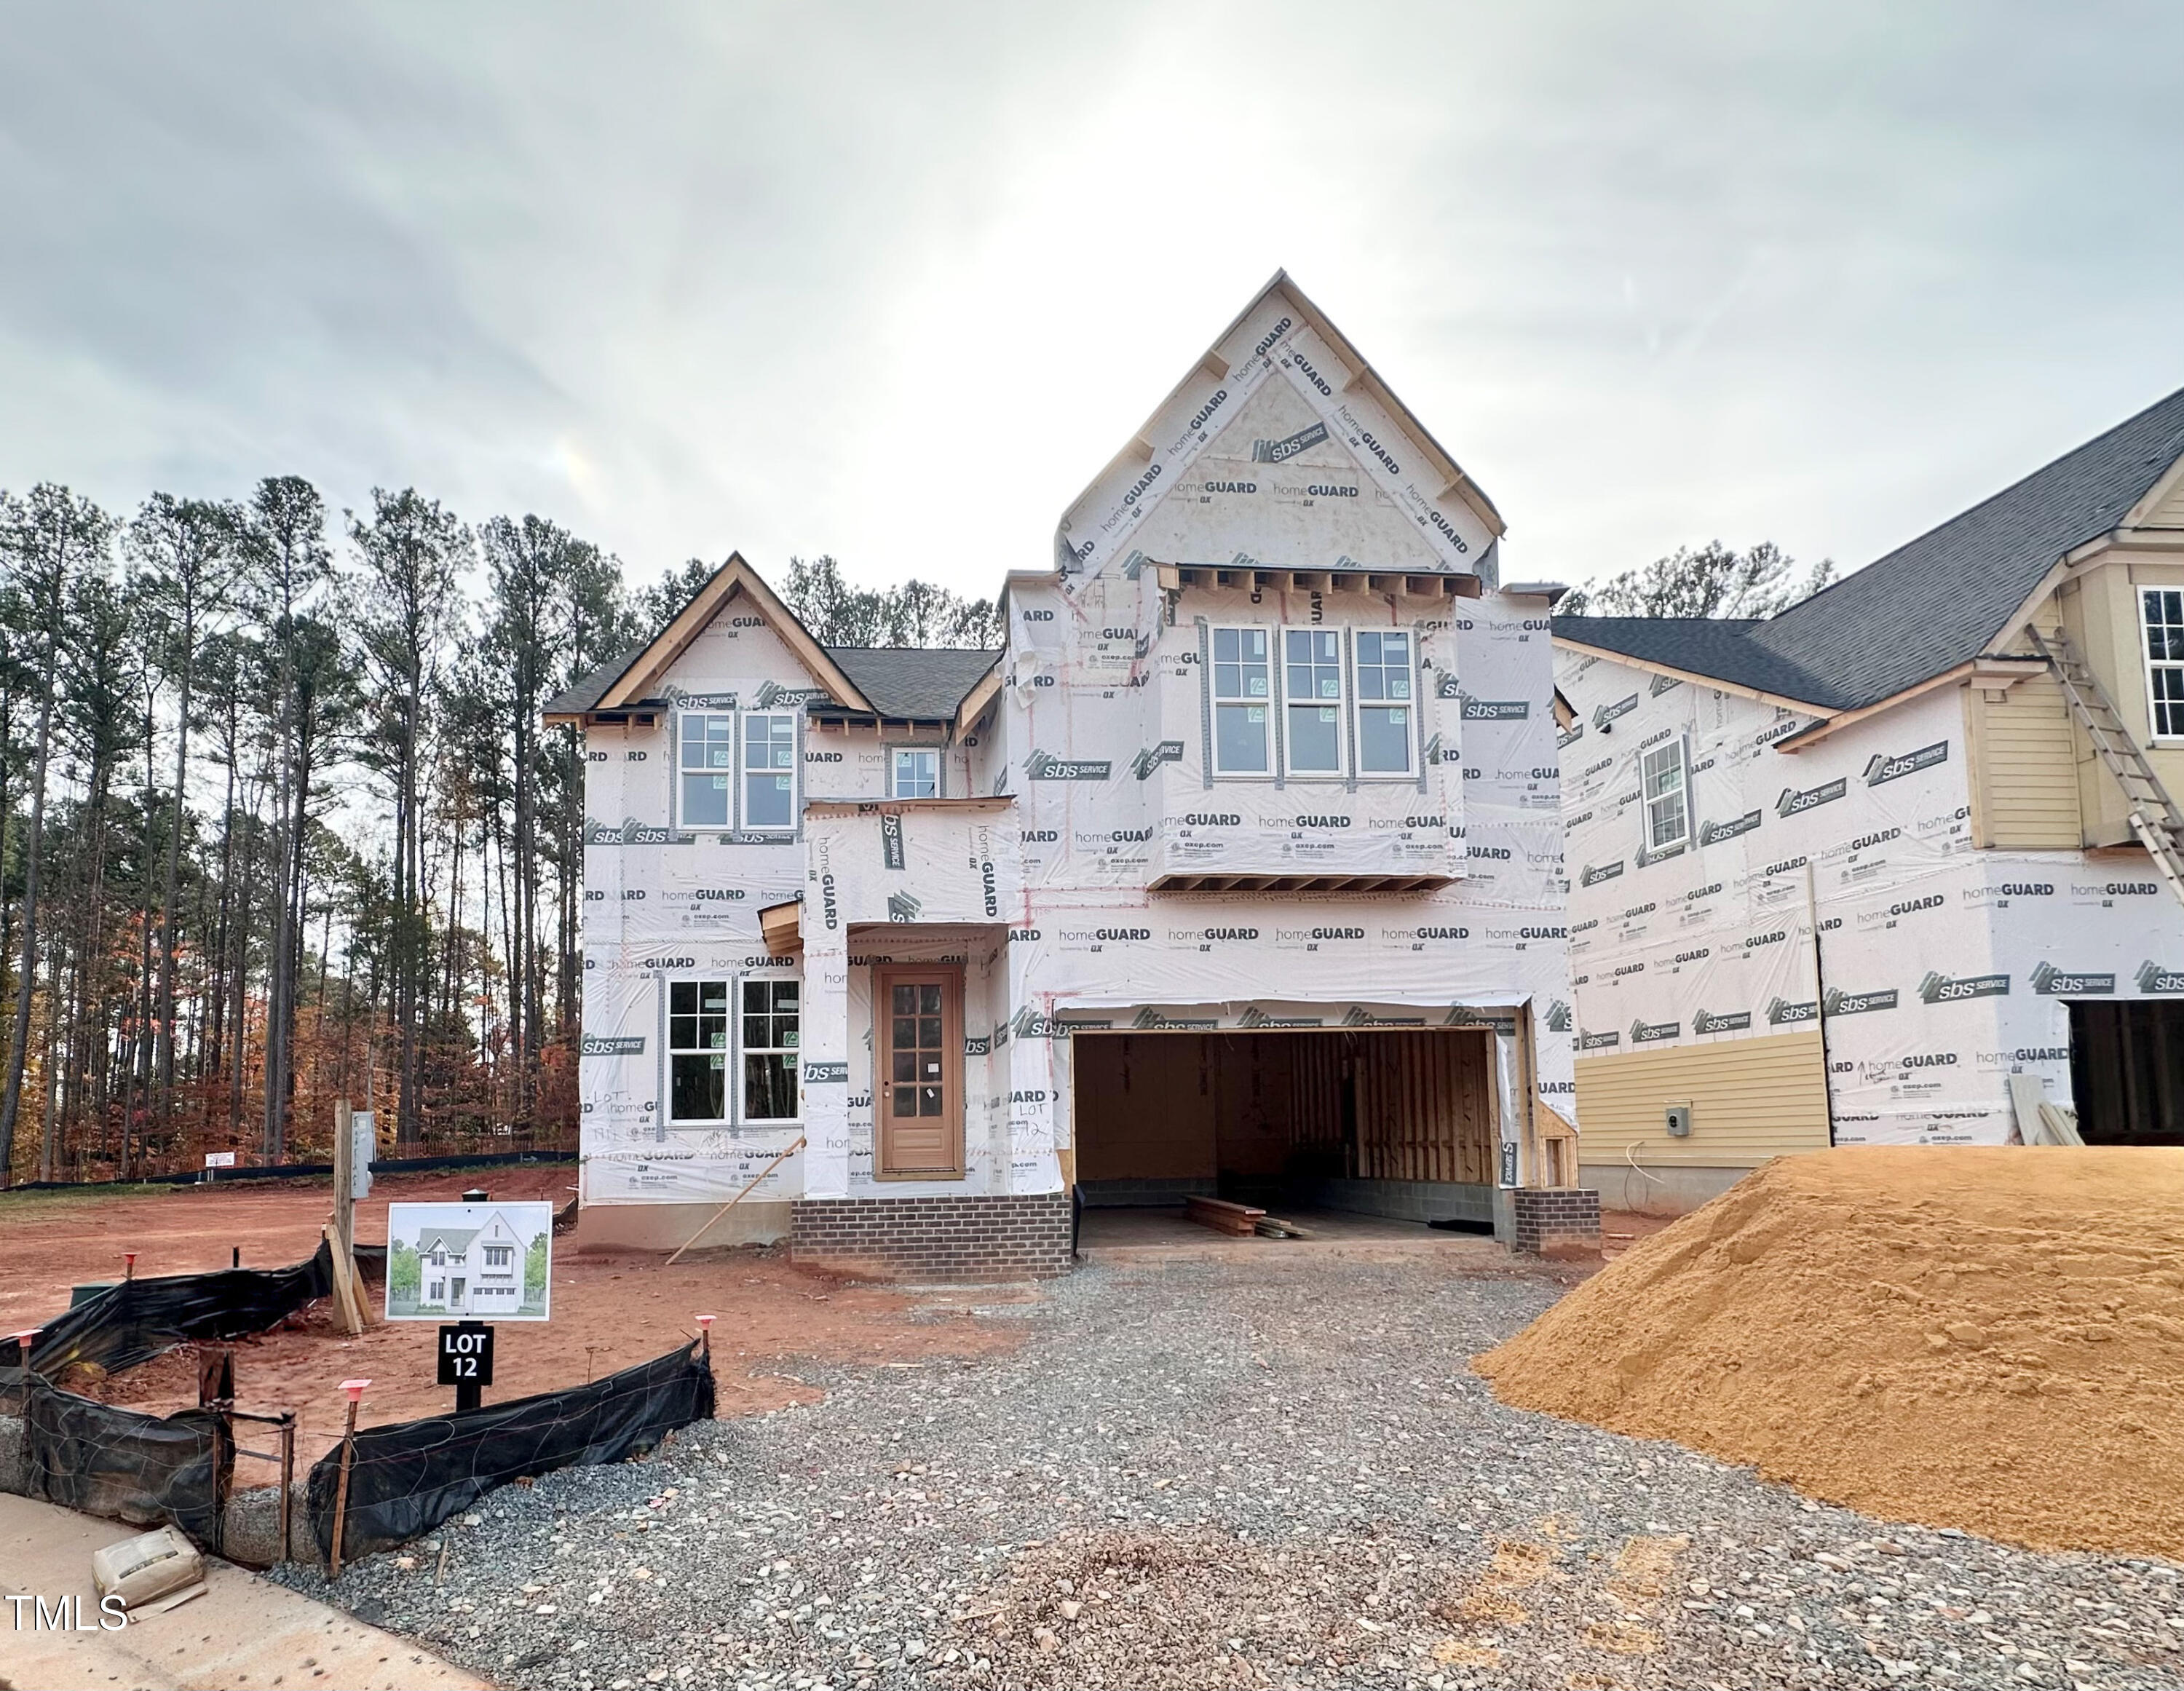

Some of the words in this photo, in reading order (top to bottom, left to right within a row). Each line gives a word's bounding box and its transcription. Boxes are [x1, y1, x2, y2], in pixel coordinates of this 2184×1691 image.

[1233, 317, 1291, 382] homeGUARD
[1167, 389, 1227, 456] homeGUARD
[1273, 438, 1302, 462] sbs
[1299, 426, 1326, 445] SERVICE
[1338, 405, 1400, 476] homeGUARD
[1273, 484, 1359, 498] homeGUARD
[1100, 464, 1163, 533] homeGUARD
[1199, 495, 1211, 504] OX
[1302, 499, 1314, 507] OX
[1406, 483, 1468, 555] homeGUARD
[1097, 643, 1109, 652] OX
[1175, 668, 1187, 676] OX
[1103, 690, 1115, 699] OX
[678, 696, 708, 708] sbs
[708, 696, 735, 705] SERVICE
[1466, 702, 1498, 717] sbs
[1499, 704, 1526, 714] SERVICE
[1915, 746, 1945, 763] SERVICE
[1043, 763, 1078, 777] sbs
[1079, 764, 1108, 774] SERVICE
[1882, 756, 1915, 780] sbs
[1791, 790, 1819, 810] sbs
[1819, 783, 1843, 798] SERVICE
[1259, 815, 1351, 828] homeGUARD
[635, 828, 667, 842] sbs
[1179, 830, 1192, 838] OX
[1291, 831, 1303, 840] OX
[1821, 827, 1902, 860] homeGUARD
[1107, 847, 1118, 855] OX
[978, 825, 997, 917] homeGUARD
[819, 836, 837, 930] homeGUARD
[2070, 883, 2158, 896] homeGUARD
[662, 889, 745, 901] homeGUARD
[1963, 883, 2054, 900] homeGUARD
[690, 903, 701, 911] OX
[1856, 895, 1944, 924] homeGUARD
[1059, 928, 1151, 942] homeGUARD
[1168, 927, 1259, 941] homeGUARD
[1275, 927, 1365, 941] homeGUARD
[1382, 927, 1469, 940] homeGUARD
[1485, 927, 1567, 940] homeGUARD
[1091, 944, 1103, 953] OX
[1199, 943, 1211, 952] OX
[1307, 943, 1318, 952] OX
[1412, 943, 1425, 951] OX
[1515, 943, 1527, 951] OX
[1720, 931, 1786, 954] homeGUARD
[711, 956, 795, 968] homeGUARD
[1939, 980, 1975, 999] sbs
[1976, 978, 2008, 990] SERVICE
[2050, 975, 2085, 991] sbs
[2084, 978, 2113, 988] SERVICE
[2154, 973, 2184, 991] sbs
[1838, 996, 1868, 1015] sbs
[1868, 994, 1895, 1007] SERVICE
[583, 1039, 614, 1054] sbs
[615, 1039, 643, 1050] SERVICE
[1868, 1053, 1958, 1071] homeGUARD
[1976, 1047, 2070, 1064] homeGUARD
[1019, 1103, 1047, 1116] LOT
[739, 1163, 750, 1171] OX
[445, 1334, 486, 1355] LOT
[453, 1357, 478, 1377] 12
